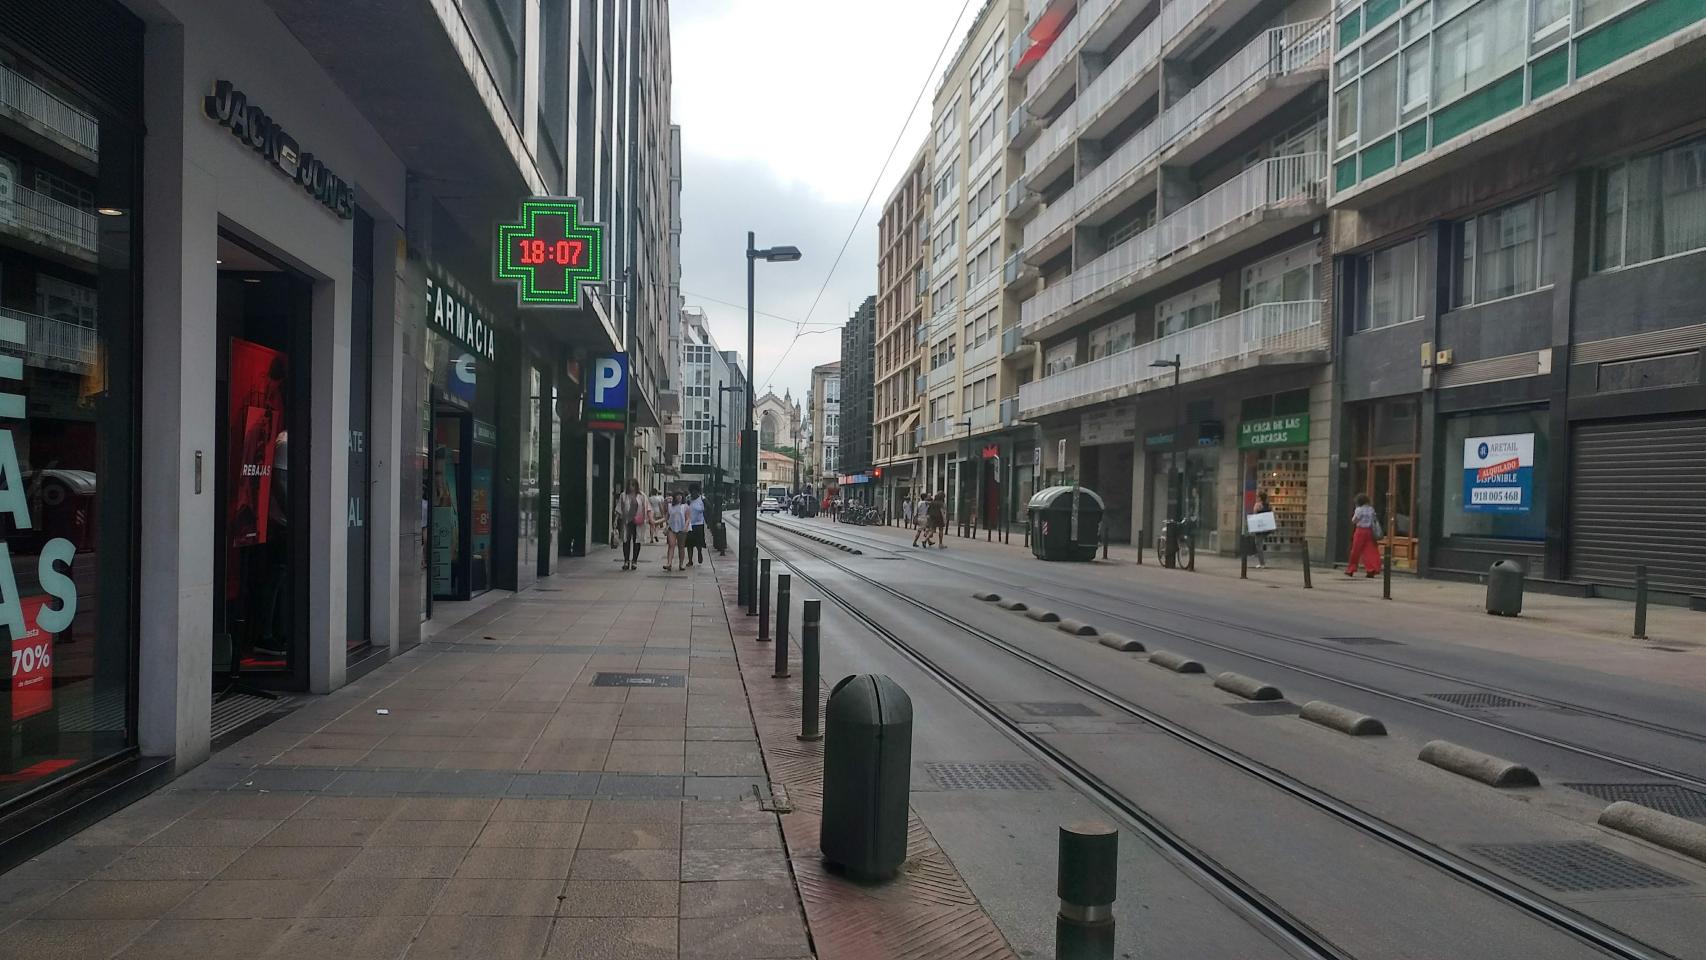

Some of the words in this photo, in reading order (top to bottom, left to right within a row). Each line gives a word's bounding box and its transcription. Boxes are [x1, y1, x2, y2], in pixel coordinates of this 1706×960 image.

[202, 80, 281, 166] JACK
[301, 153, 354, 219] JONES
[519, 240, 582, 264] 18:07
[425, 277, 495, 362] FARMACIA
[595, 358, 622, 403] P
[1242, 424, 1251, 434] LA
[1253, 421, 1271, 432] CASA
[1285, 418, 1300, 429] LAS
[1490, 442, 1518, 452] ARETAIL
[242, 463, 271, 477] REBAJAS
[1483, 461, 1516, 477] ALQUILADO
[1474, 491, 1488, 501] 918
[1489, 491, 1502, 501] 005
[1504, 490, 1518, 501] 468
[347, 497, 363, 528] AL
[11, 643, 50, 677] 70%
